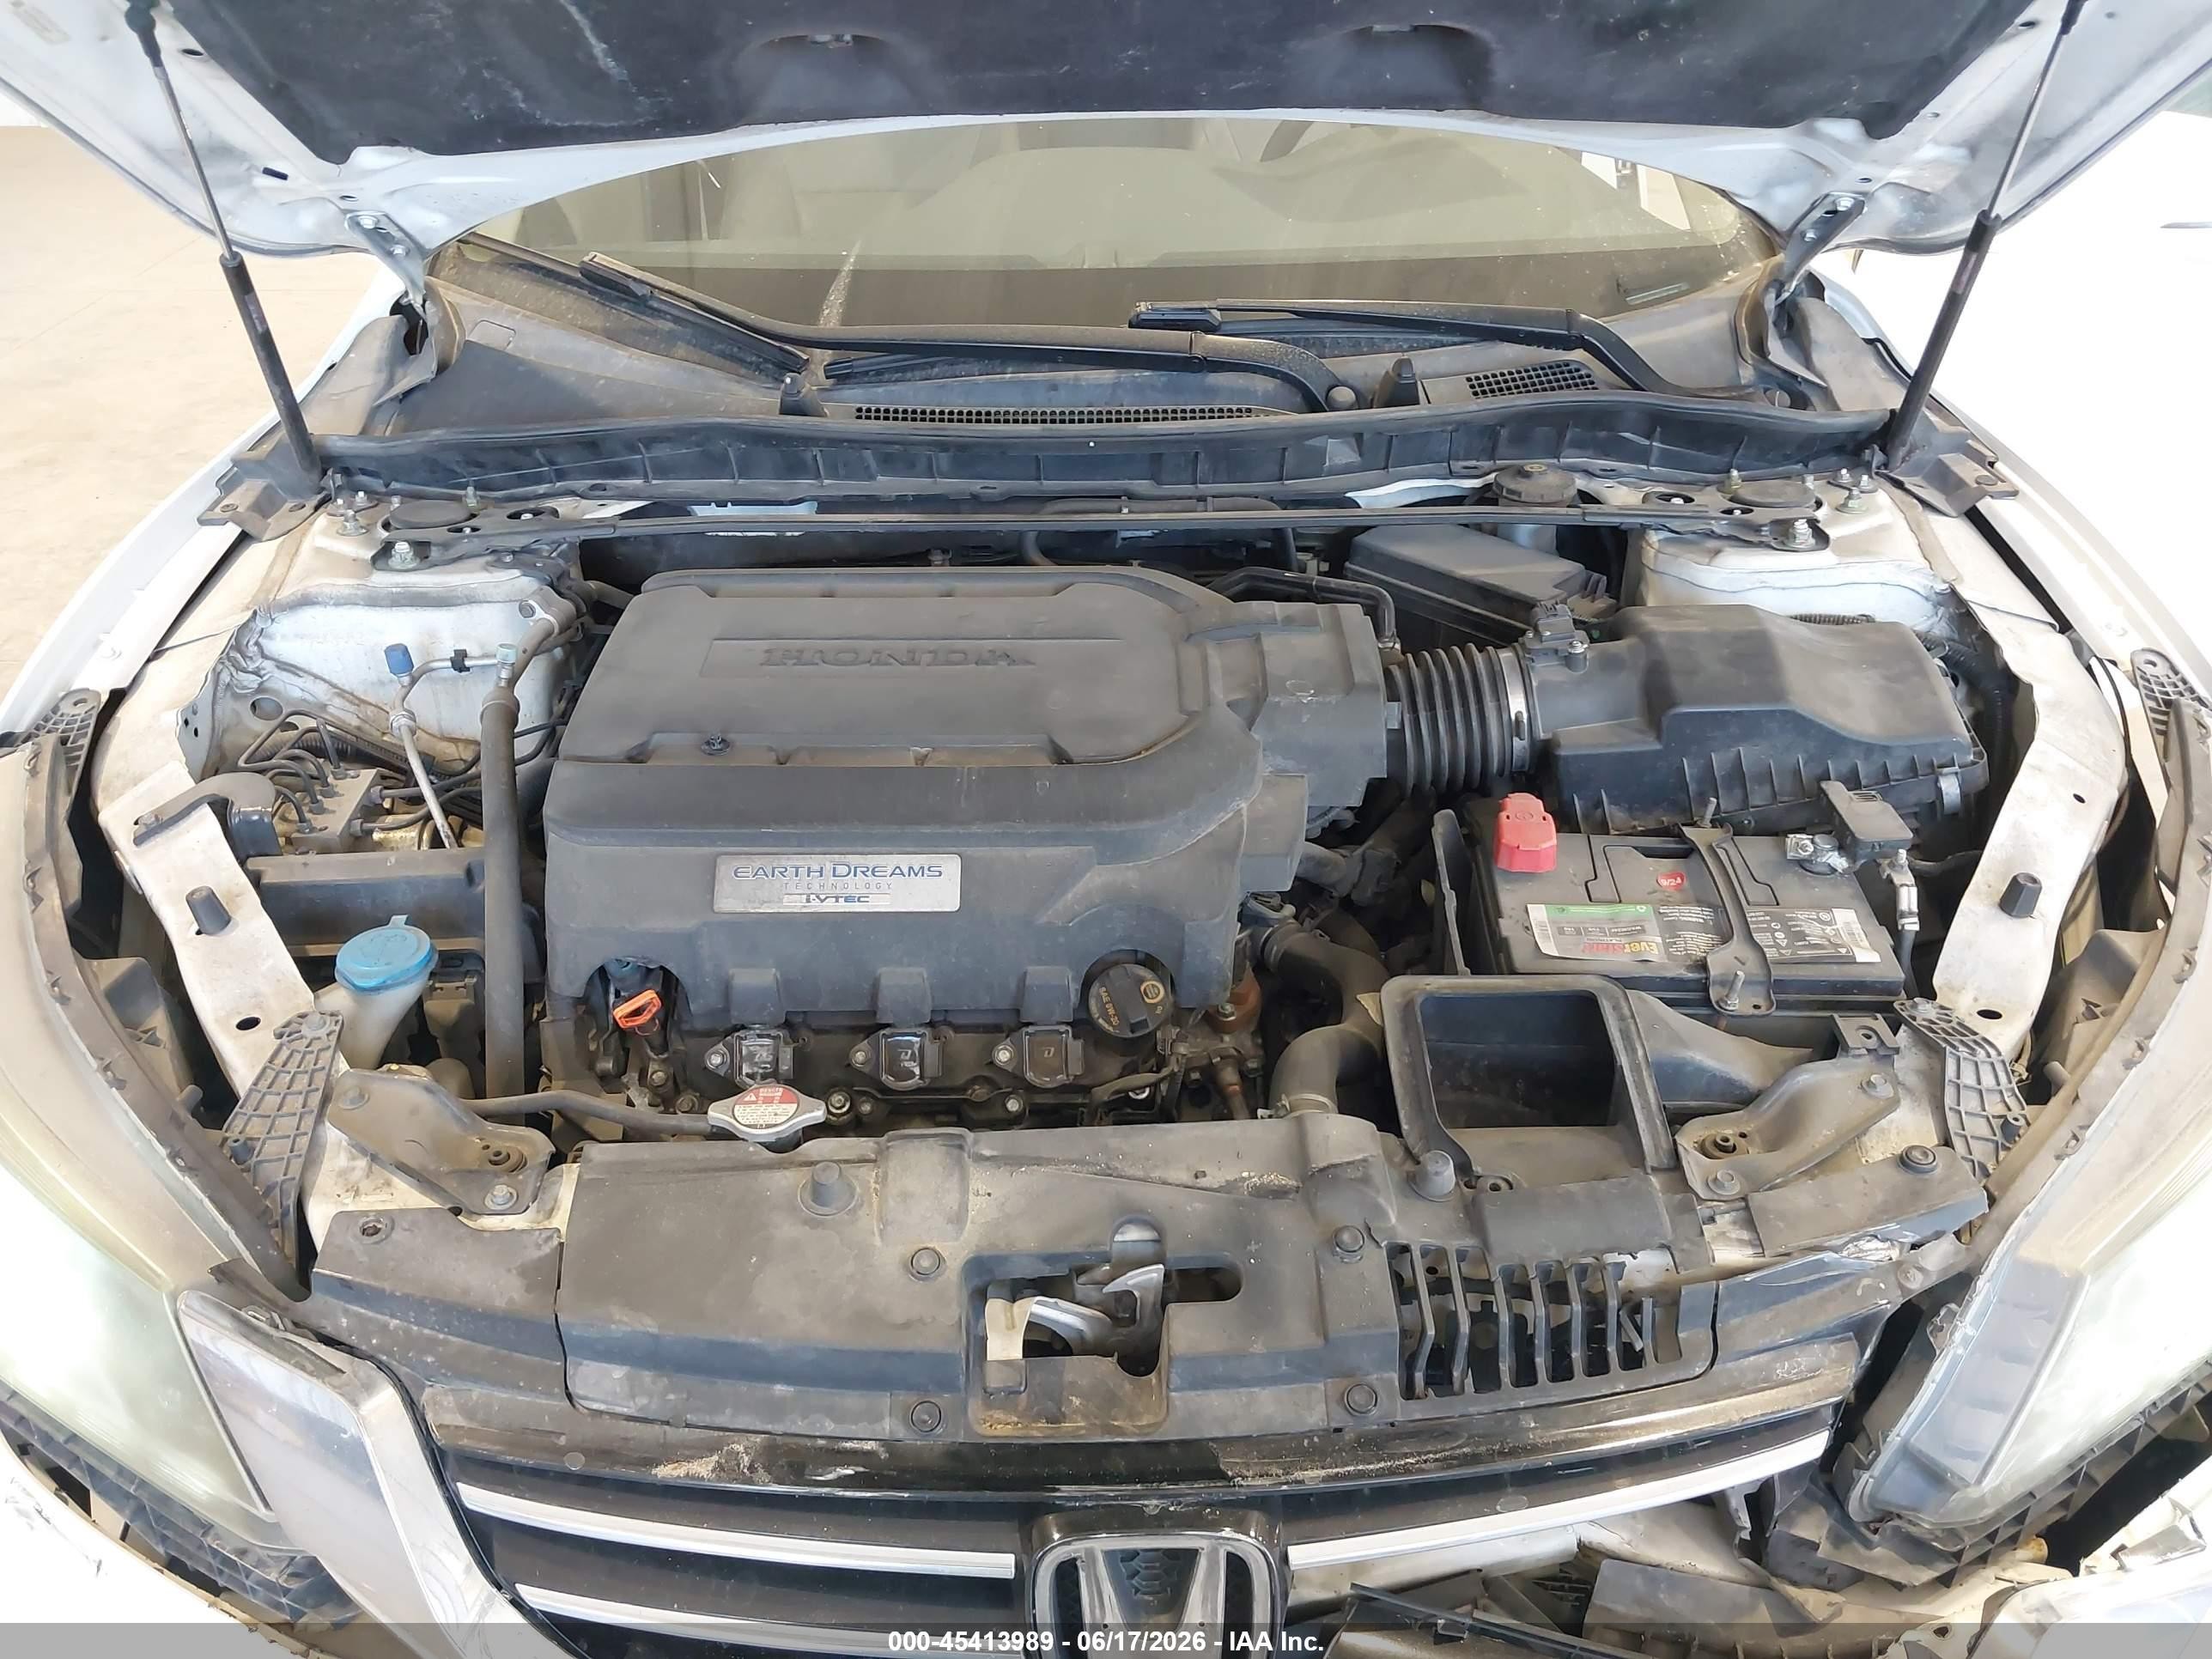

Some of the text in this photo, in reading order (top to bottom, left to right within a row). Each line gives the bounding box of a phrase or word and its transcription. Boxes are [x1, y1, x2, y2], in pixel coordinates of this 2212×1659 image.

[761, 647, 1036, 667] HONDA
[732, 863, 944, 879] EARTH DREAMS
[783, 882, 893, 890] TECHNOLOGY
[805, 893, 871, 904] i-VTEC
